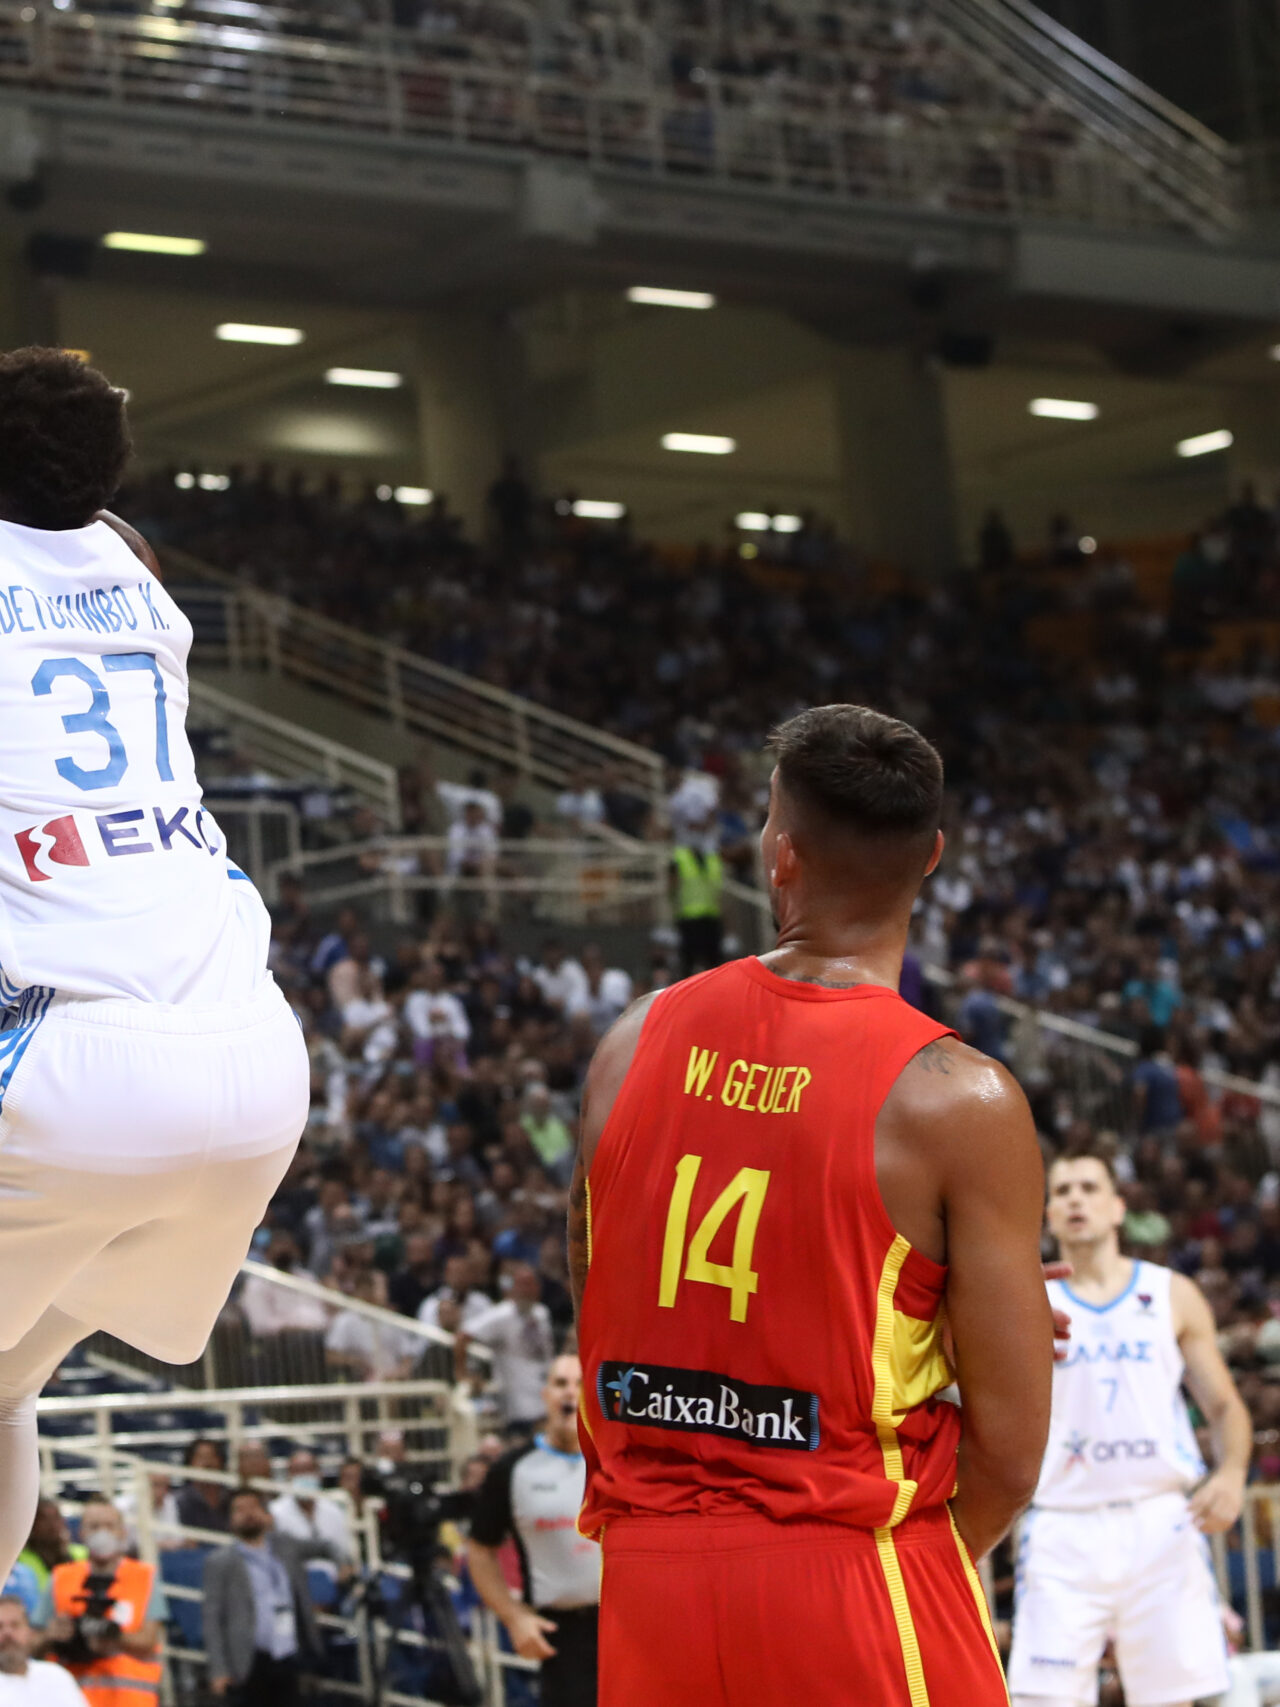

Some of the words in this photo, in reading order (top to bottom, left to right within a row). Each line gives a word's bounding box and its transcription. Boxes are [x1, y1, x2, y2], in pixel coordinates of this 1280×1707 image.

[139, 581, 170, 630] K.
[30, 651, 175, 791] 37
[683, 1045, 719, 1101] W.
[720, 1058, 812, 1114] GEUER
[657, 1153, 771, 1323] 14
[625, 1371, 807, 1442] CaixaBank
[1098, 1377, 1119, 1413] 7
